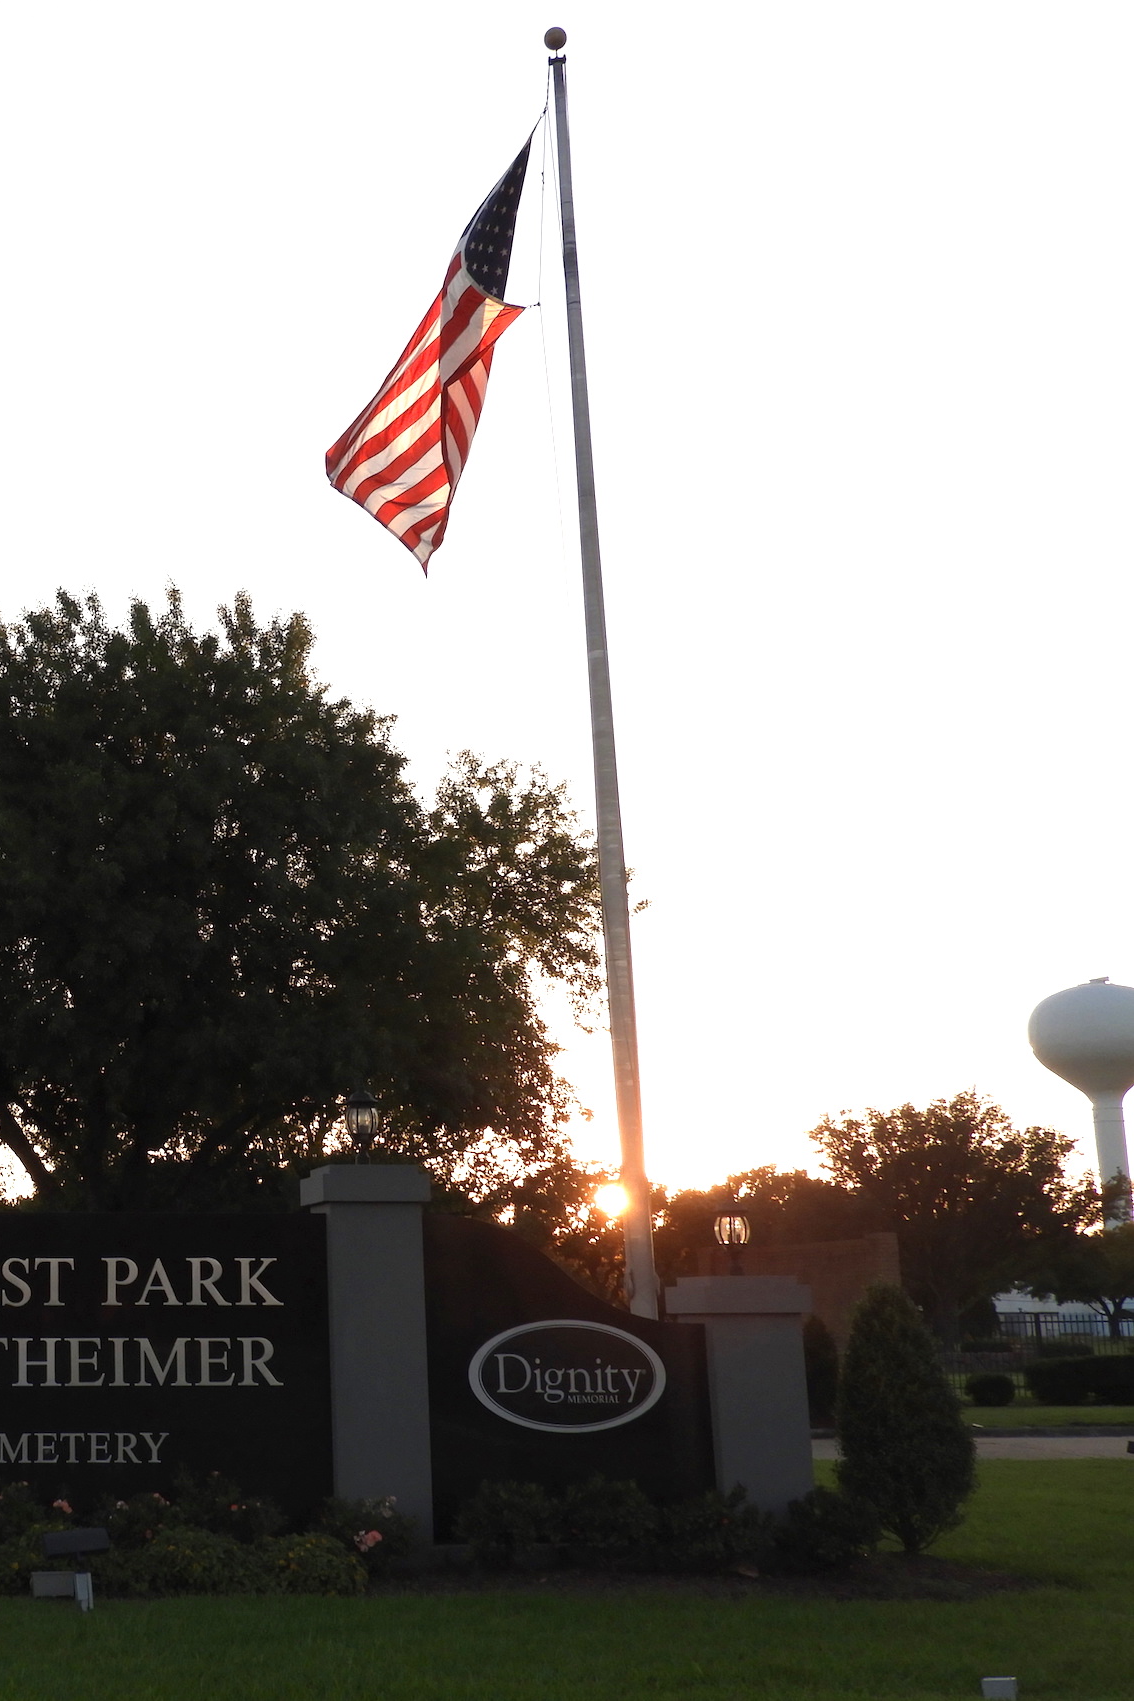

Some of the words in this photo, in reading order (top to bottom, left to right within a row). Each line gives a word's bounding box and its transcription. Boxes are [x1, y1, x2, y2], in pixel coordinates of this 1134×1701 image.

[101, 1257, 284, 1306] PARK
[494, 1353, 641, 1403] Dignity
[567, 1394, 620, 1404] MEMORIAL
